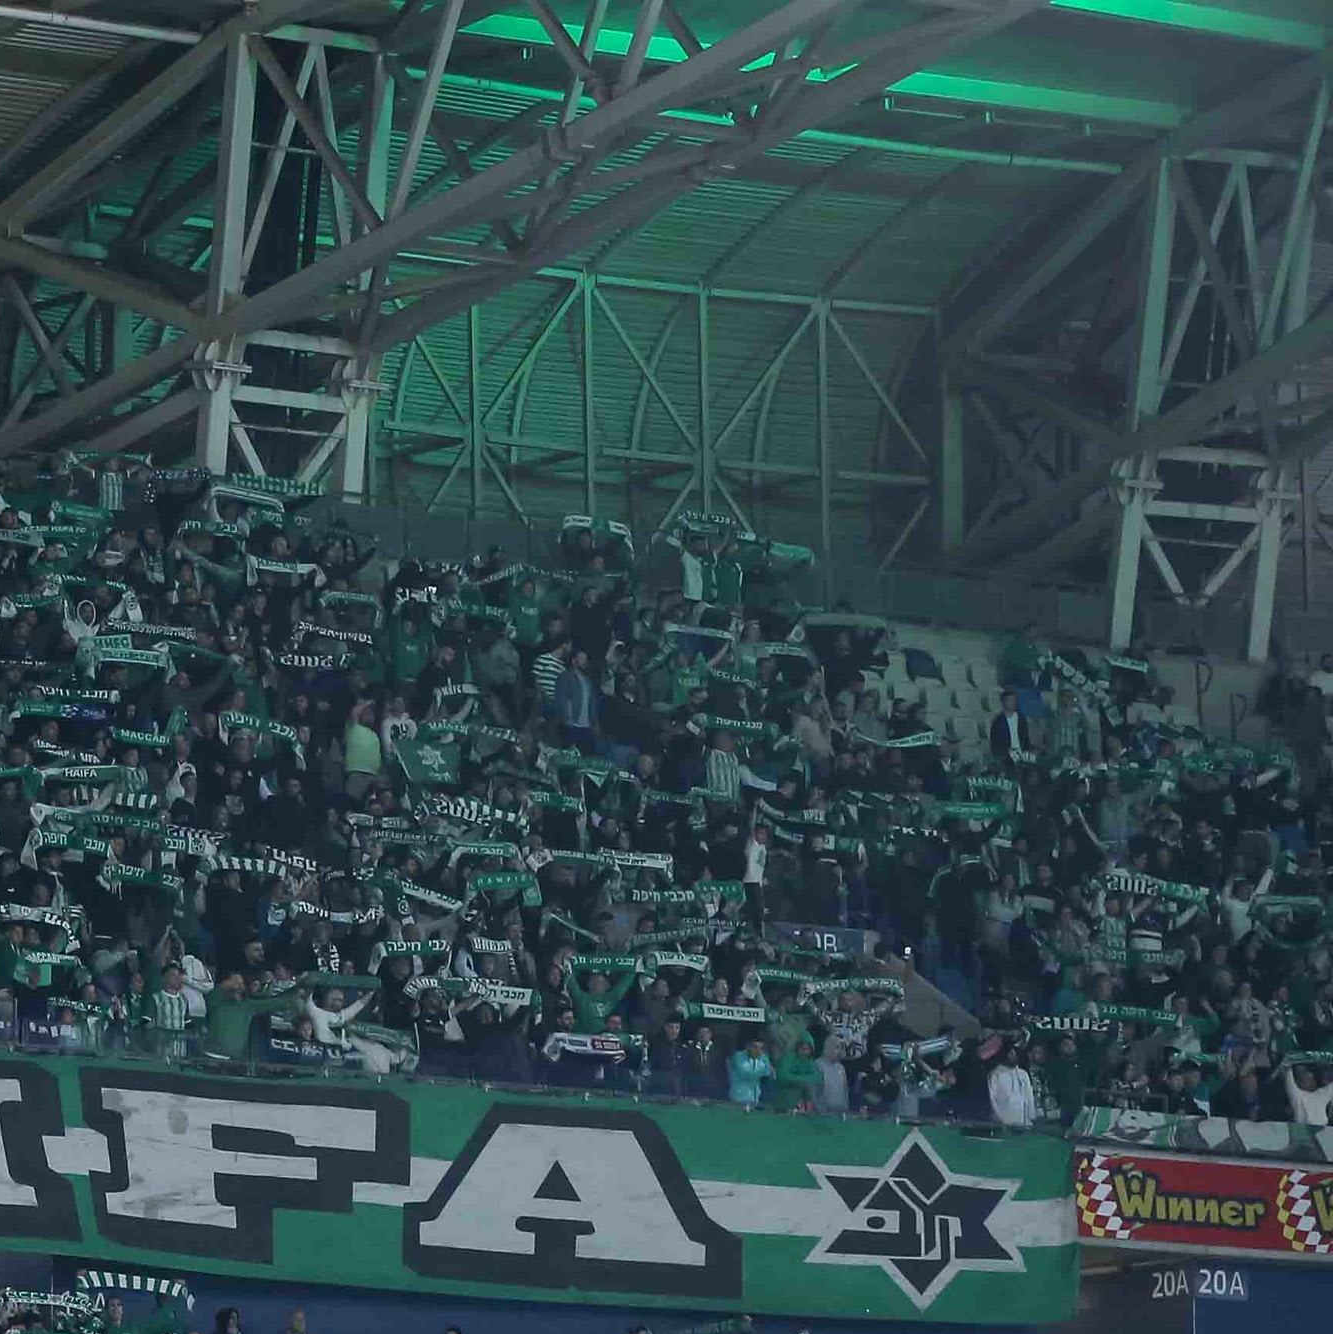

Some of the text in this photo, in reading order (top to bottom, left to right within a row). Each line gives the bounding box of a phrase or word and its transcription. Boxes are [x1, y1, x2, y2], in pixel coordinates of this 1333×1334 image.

[65, 766, 98, 777] HAIFA
[1115, 1172, 1267, 1229] Winner
[1151, 1271, 1189, 1299] 20A
[1197, 1269, 1245, 1297] 20A
